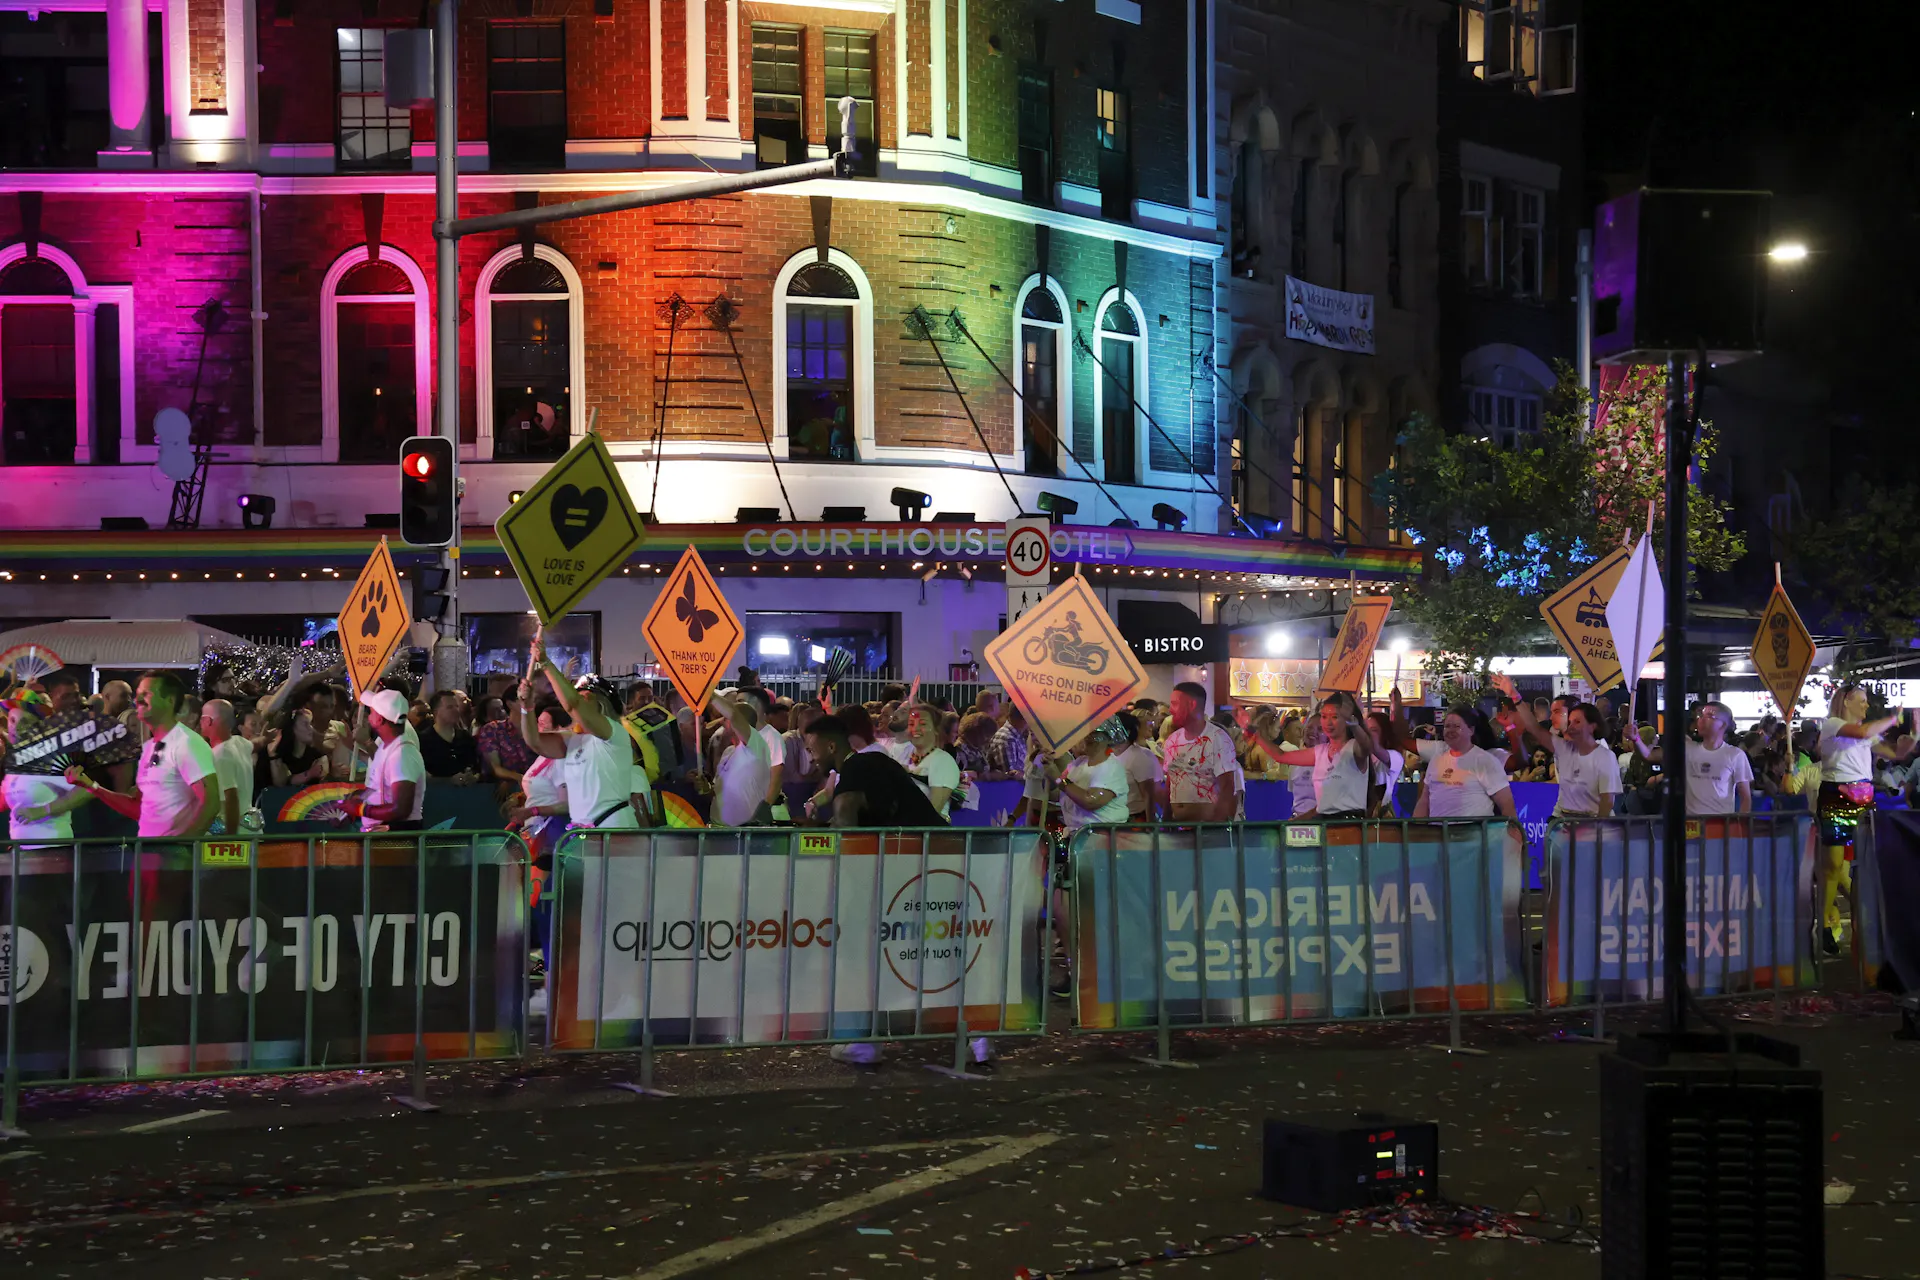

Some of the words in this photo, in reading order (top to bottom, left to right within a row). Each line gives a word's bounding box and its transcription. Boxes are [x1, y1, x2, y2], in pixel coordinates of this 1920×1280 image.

[743, 528, 1006, 557] COURTHOUSE
[1051, 530, 1117, 560] OTEL
[1013, 541, 1043, 562] 40
[543, 557, 573, 570] LOVE
[574, 559, 585, 571] IS
[546, 572, 576, 586] LOVE
[358, 644, 377, 654] BEARS
[1144, 637, 1204, 653] BISTRO
[1581, 635, 1603, 647] BUS
[1605, 639, 1614, 649] S
[357, 656, 376, 667] AHEAD
[671, 650, 698, 661] THANK
[699, 651, 716, 662] YOU
[1586, 648, 1619, 662] AHEA
[680, 663, 707, 675] 78ER'S
[1016, 669, 1054, 686] DYKES
[1056, 677, 1074, 690] ON
[1076, 680, 1111, 697] BIKES
[1040, 688, 1082, 705] AHEAD
[13, 736, 58, 765] HIGH
[60, 720, 96, 747] END
[83, 723, 127, 753] GAYS
[1290, 827, 1316, 840] TFH
[803, 836, 830, 848] TFH
[207, 843, 241, 857] TFH
